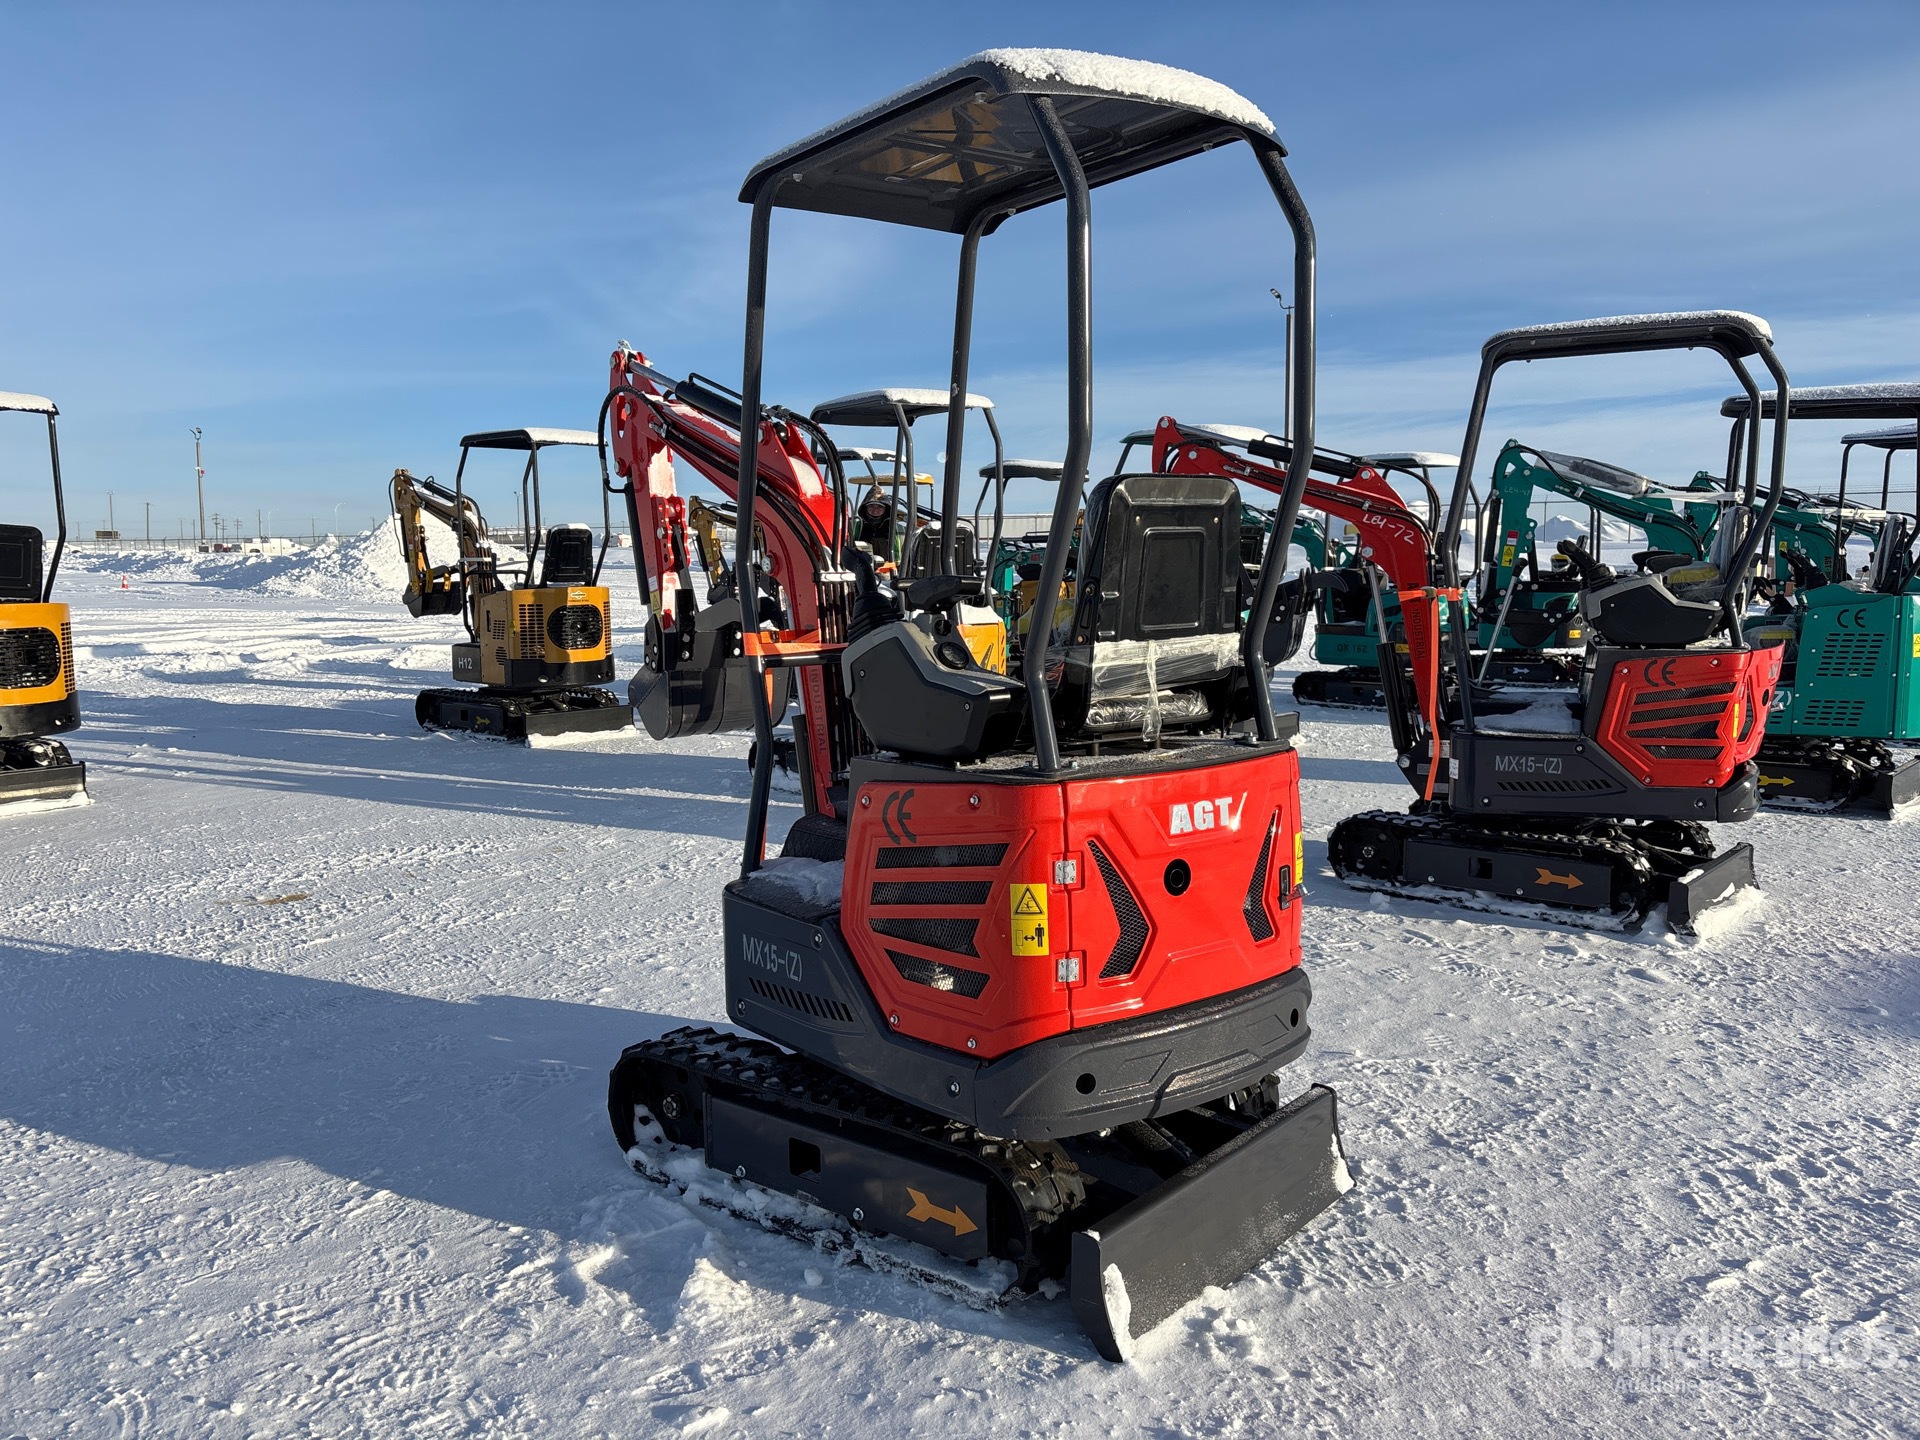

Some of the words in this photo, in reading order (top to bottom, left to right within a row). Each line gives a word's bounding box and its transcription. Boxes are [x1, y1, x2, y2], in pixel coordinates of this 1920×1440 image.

[1362, 513, 1415, 545] LE4-72
[1411, 608, 1426, 660] INDUSTRIAL
[458, 657, 473, 670] H12
[1643, 659, 1677, 688] CE
[809, 668, 827, 755] INDUSTRIAL
[1495, 755, 1562, 774] MX15-(Z)
[881, 788, 917, 845] CE
[1170, 796, 1233, 836] AGT
[742, 934, 803, 982] MX15-(Z)
